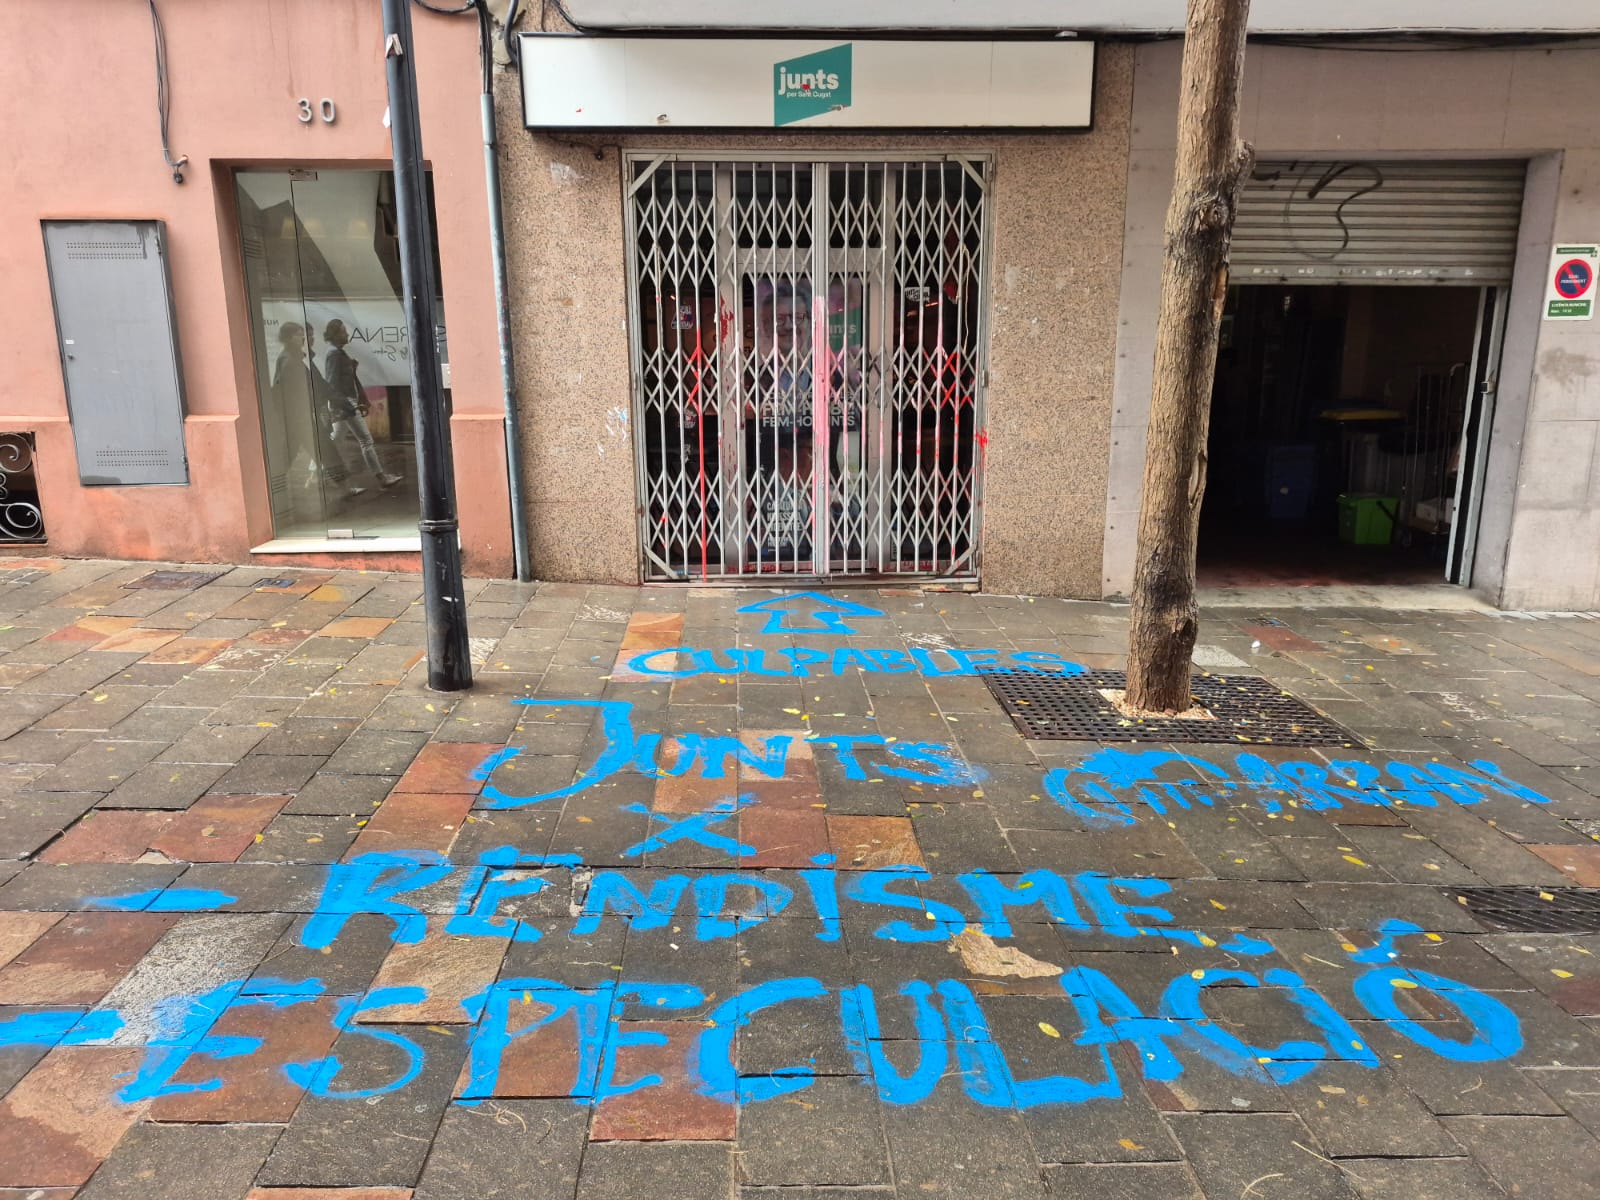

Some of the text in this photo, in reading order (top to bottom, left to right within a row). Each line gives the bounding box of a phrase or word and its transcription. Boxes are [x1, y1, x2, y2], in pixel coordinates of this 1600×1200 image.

[778, 66, 839, 95] junts
[297, 98, 336, 124] 30
[628, 647, 1086, 679] CULPABLES
